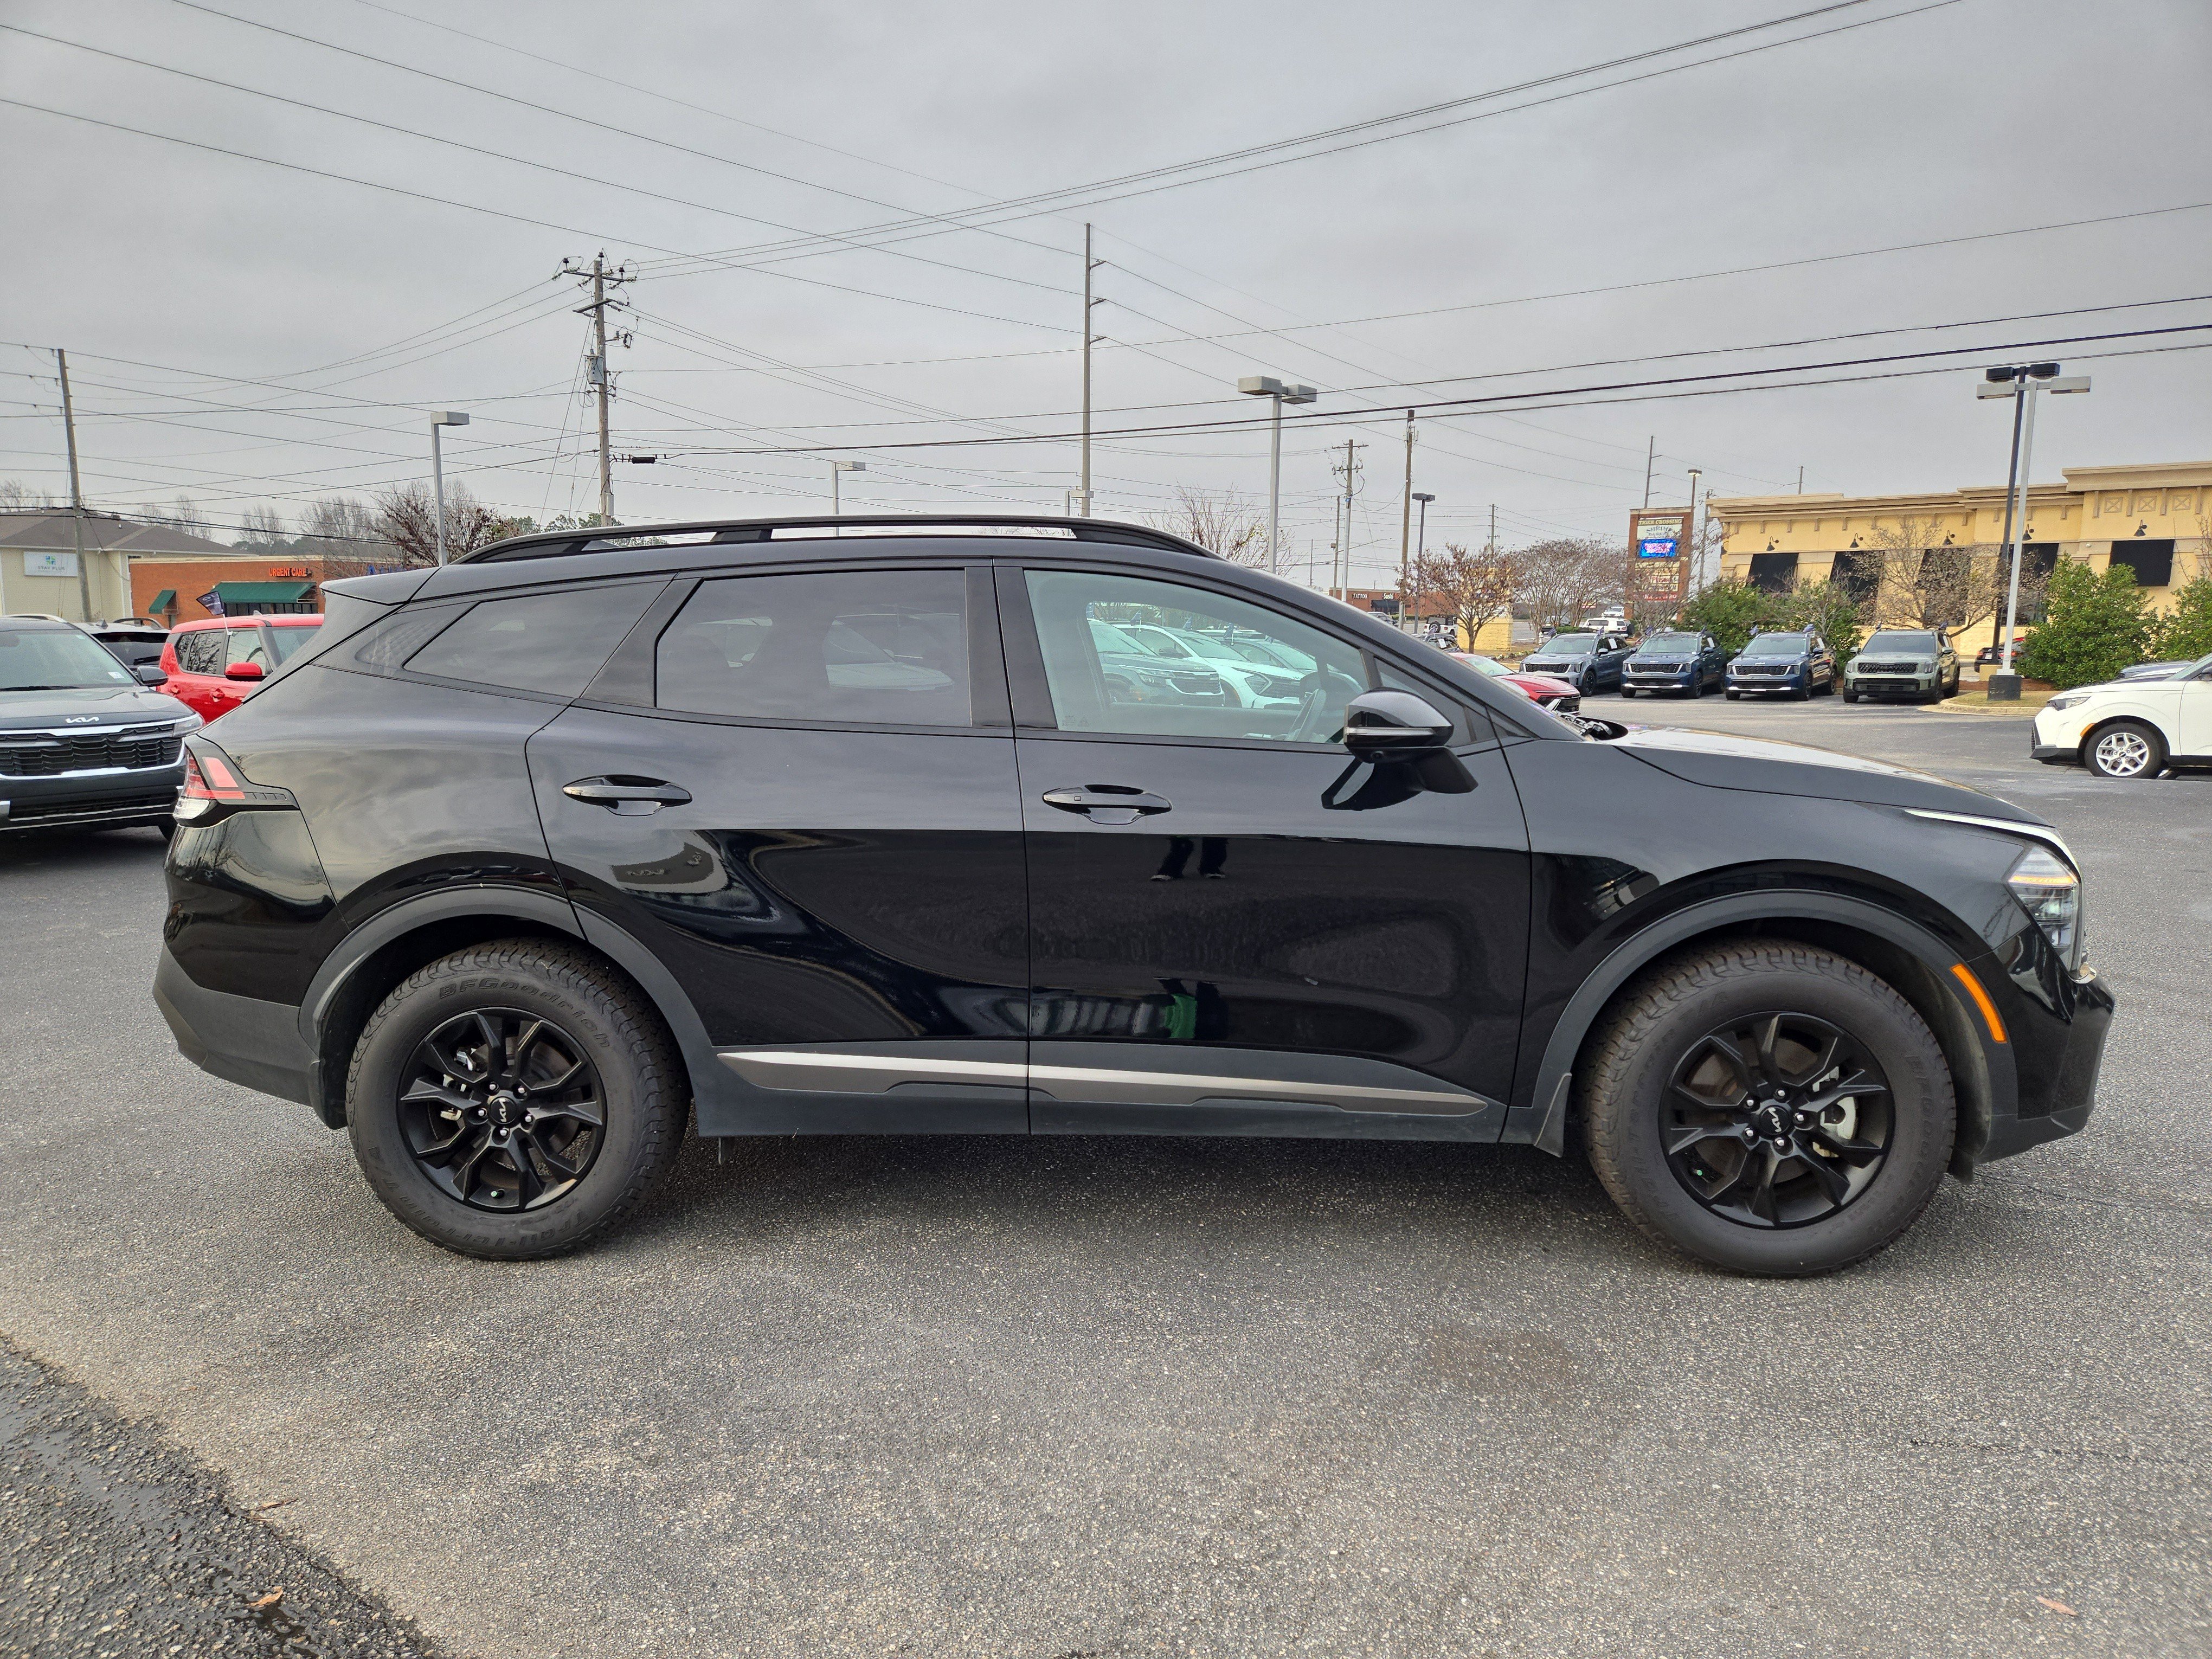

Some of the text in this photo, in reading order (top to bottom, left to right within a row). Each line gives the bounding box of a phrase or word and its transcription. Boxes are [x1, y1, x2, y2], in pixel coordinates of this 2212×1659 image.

[269, 567, 307, 577] URGENT CARE
[439, 978, 610, 1048] BFGoodrich
